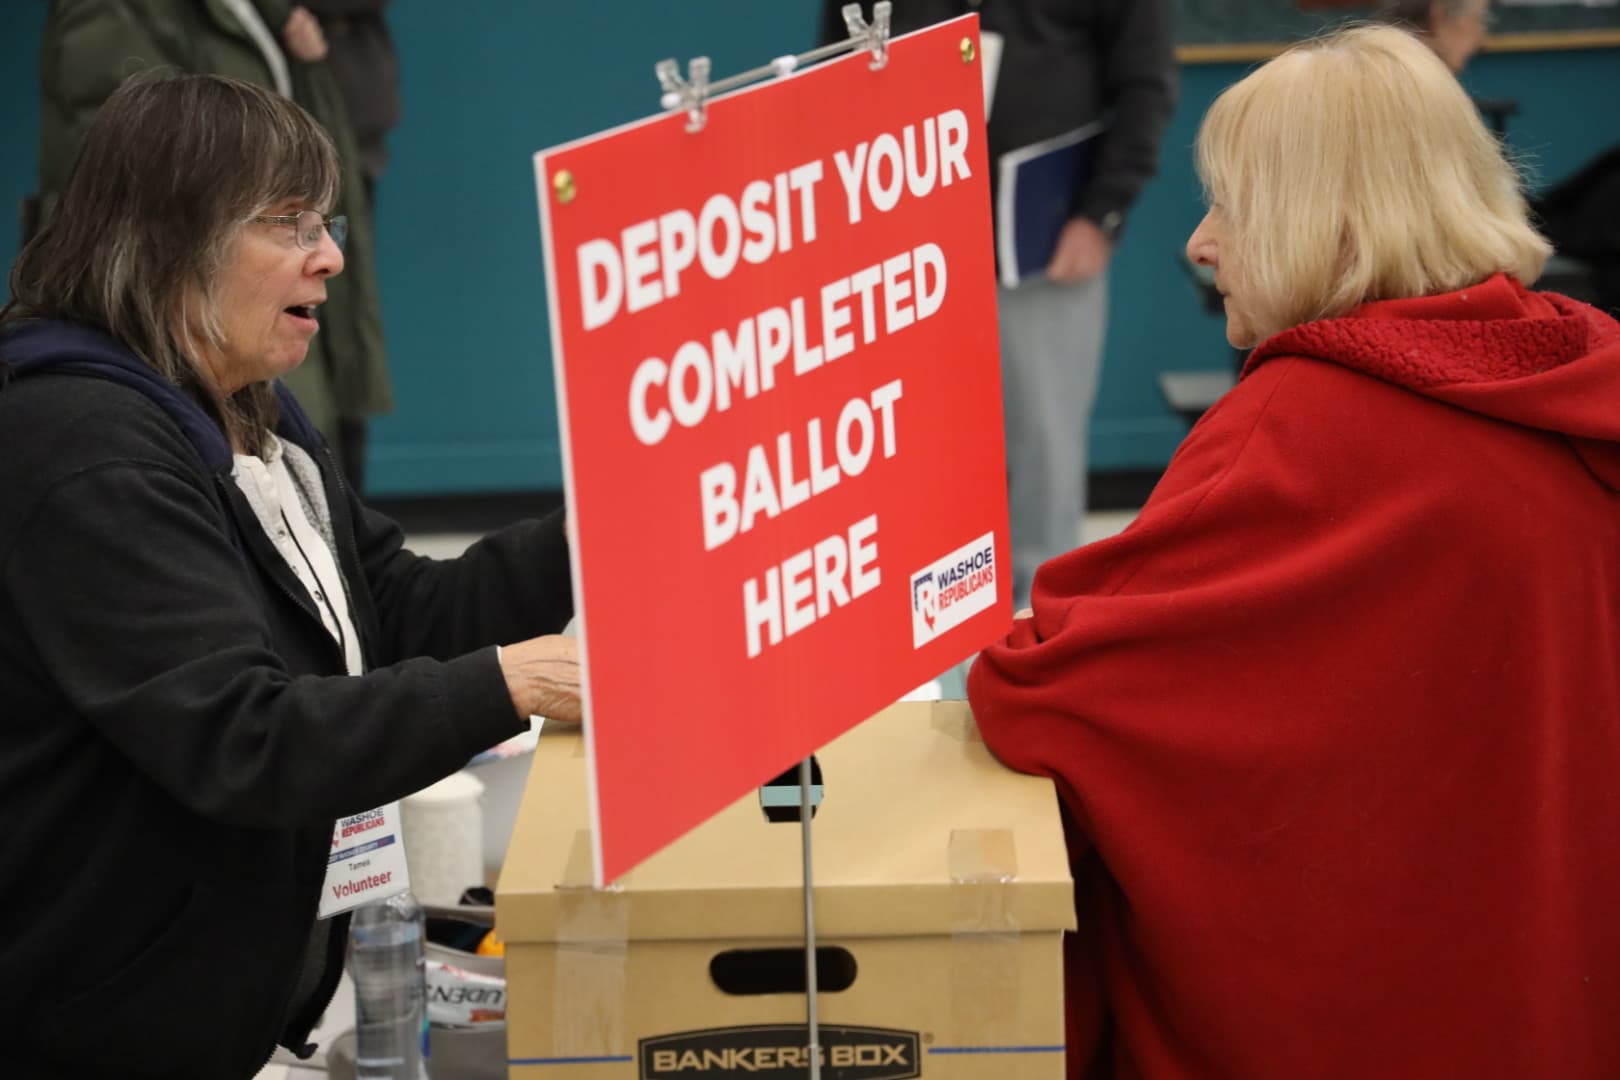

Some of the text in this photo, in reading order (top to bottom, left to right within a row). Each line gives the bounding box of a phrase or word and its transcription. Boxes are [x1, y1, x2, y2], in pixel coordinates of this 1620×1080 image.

[577, 109, 972, 330] DEPOSIT YOUR
[629, 243, 947, 445] COMPLETED
[700, 380, 903, 551] BALLOT
[743, 514, 881, 658] HERE
[938, 547, 993, 589] WASHOE
[939, 565, 994, 610] REPUBLICANS
[341, 807, 384, 827] WASHOE
[341, 816, 385, 838] REPUBLICANS
[332, 872, 392, 899] Volunteer
[653, 1043, 909, 1073] BANKERS BOX
